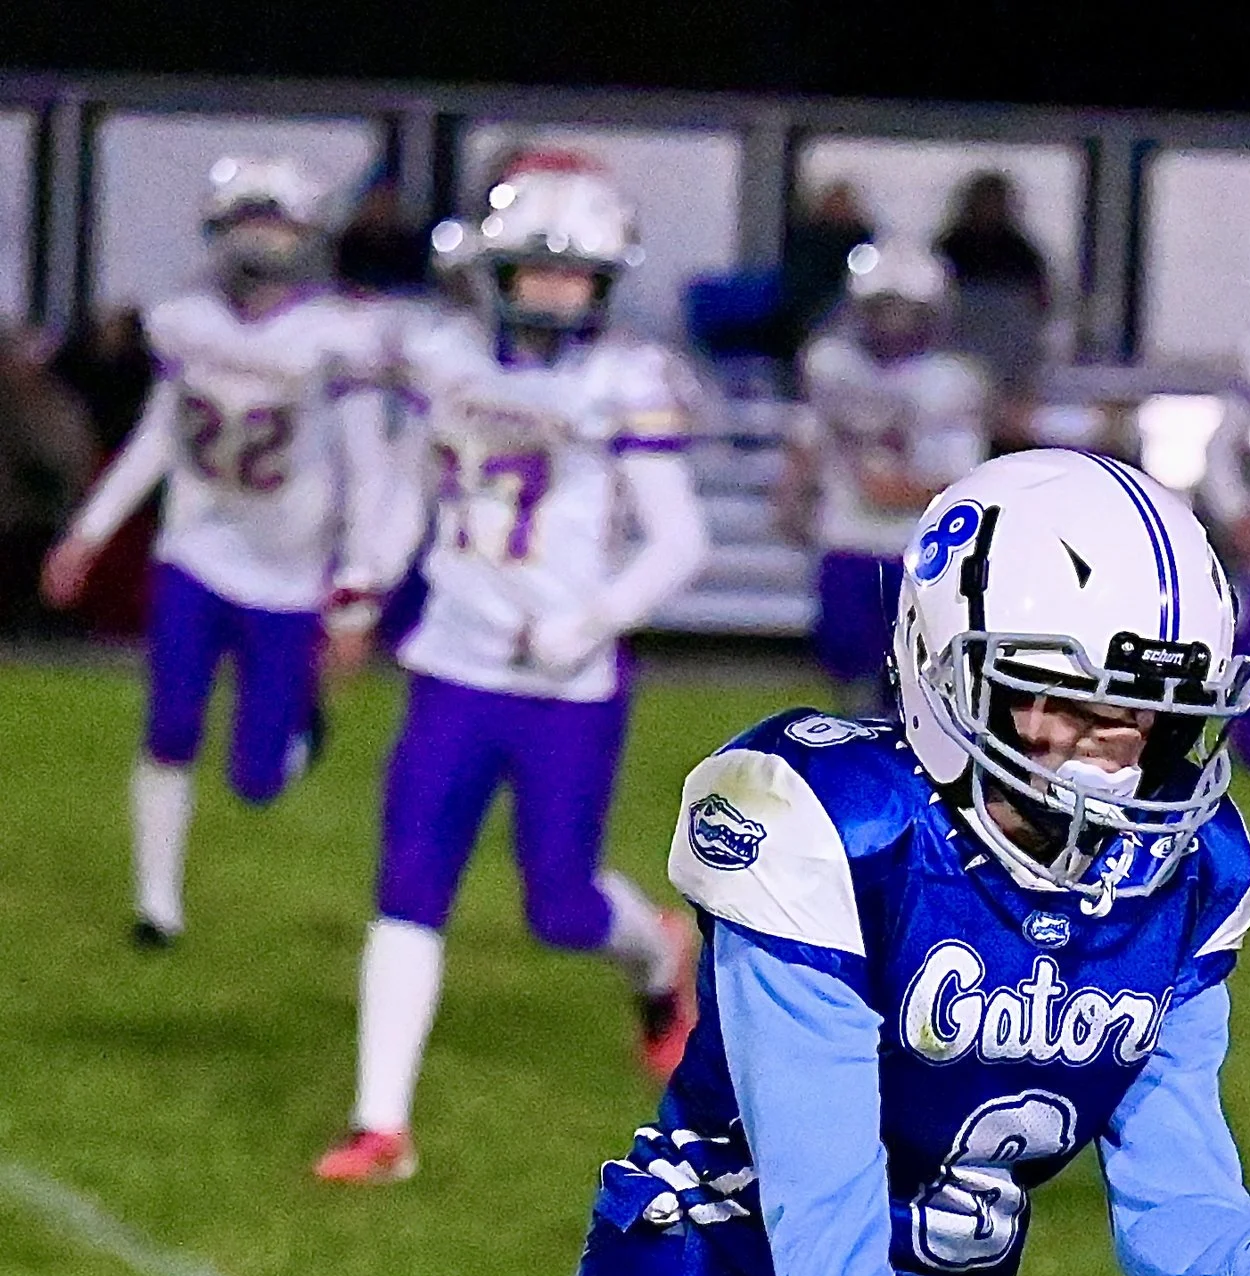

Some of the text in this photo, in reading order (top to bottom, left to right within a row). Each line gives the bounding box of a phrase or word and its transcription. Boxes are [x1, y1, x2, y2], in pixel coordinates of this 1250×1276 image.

[432, 442, 549, 558] 17
[916, 498, 984, 587] 8
[901, 938, 1173, 1066] Gator
